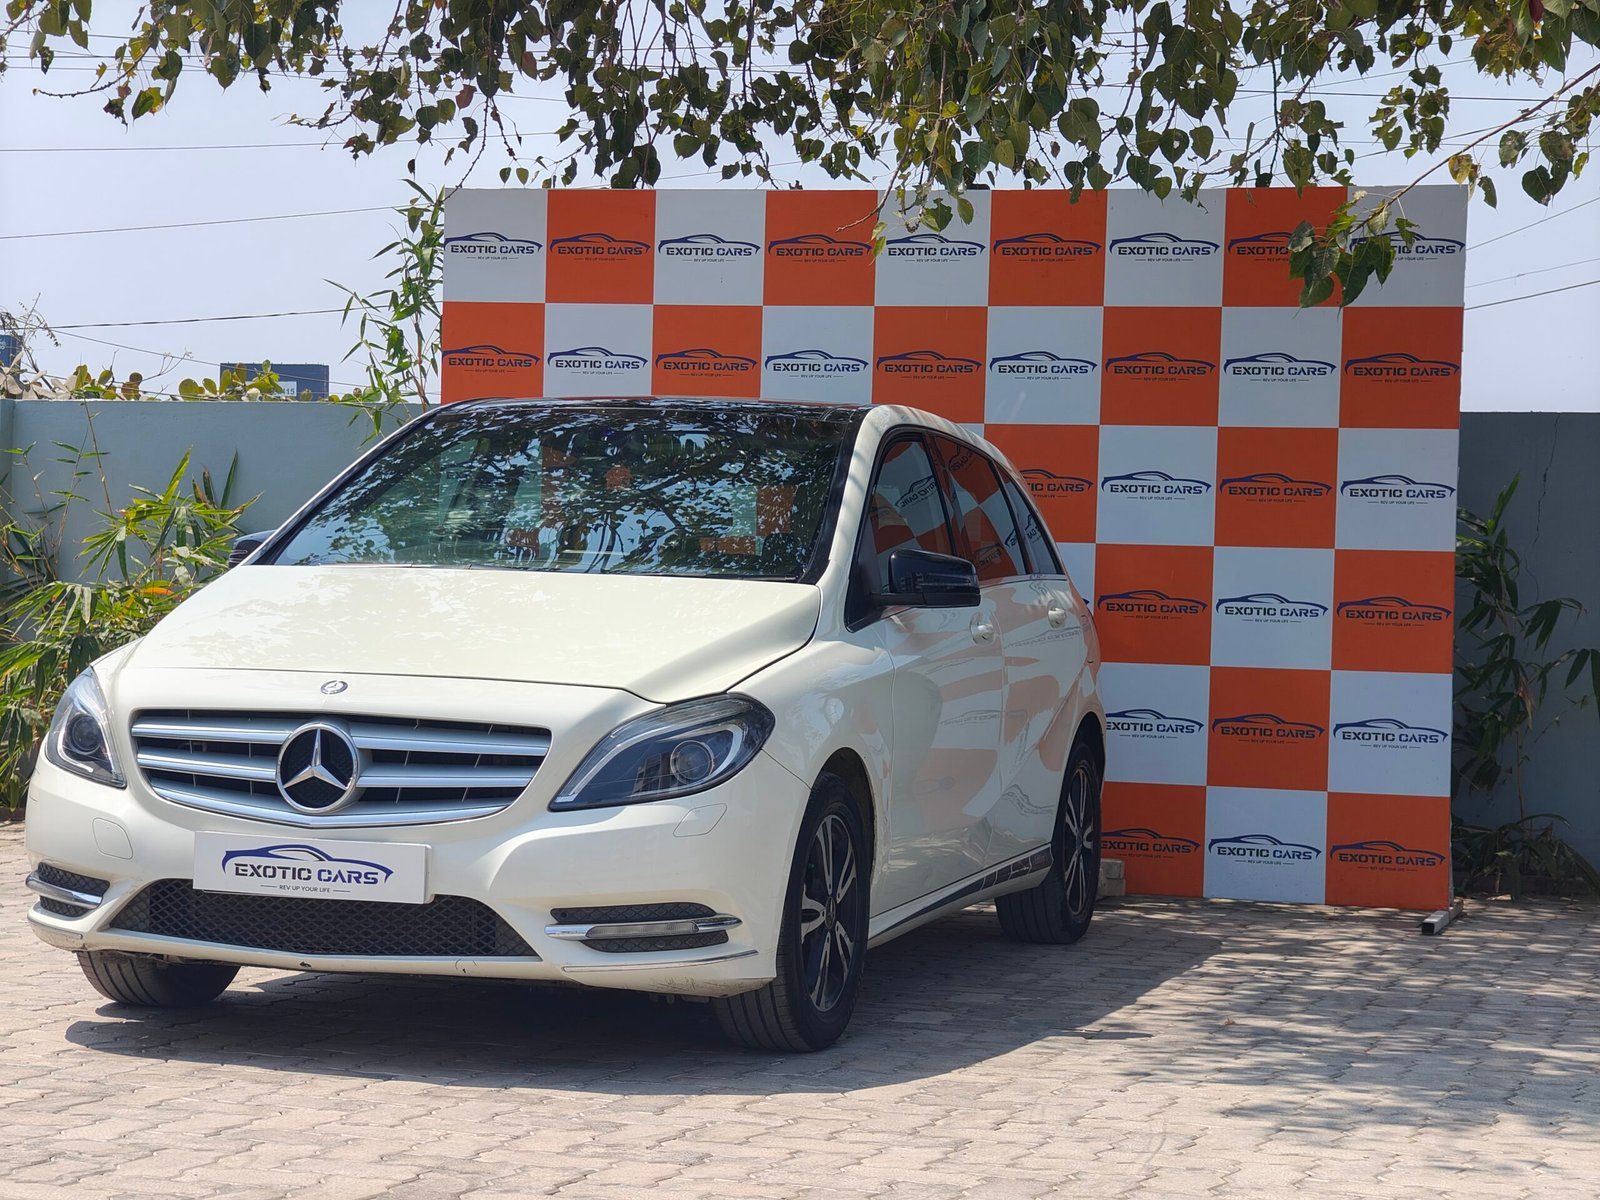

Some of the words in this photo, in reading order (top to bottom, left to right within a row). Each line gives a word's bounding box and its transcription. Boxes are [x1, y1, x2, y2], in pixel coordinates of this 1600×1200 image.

[451, 245, 497, 254] EXOTIC
[500, 245, 534, 254] CARS
[558, 246, 605, 255] EXOTIC
[607, 246, 642, 255] CARS
[666, 247, 714, 256] EXOTIC
[716, 247, 752, 256] CARS
[776, 247, 824, 256] EXOTIC
[828, 247, 863, 256] CARS
[888, 248, 937, 256] EXOTIC
[939, 247, 976, 256] CARS
[1002, 247, 1051, 256] EXOTIC
[1054, 247, 1092, 256] CARS
[1118, 246, 1169, 255] EXOTIC
[1172, 246, 1210, 255] CARS
[1415, 245, 1456, 254] CARS
[448, 358, 493, 367] EXOTIC
[497, 358, 532, 367] CARS
[555, 359, 602, 369] EXOTIC
[605, 360, 640, 369] CARS
[663, 361, 710, 371] EXOTIC
[713, 362, 749, 371] CARS
[773, 363, 821, 372] EXOTIC
[824, 363, 860, 372] CARS
[885, 364, 934, 373] EXOTIC
[936, 364, 973, 373] CARS
[998, 364, 1048, 374] EXOTIC
[1051, 365, 1088, 374] CARS
[1114, 365, 1165, 375] EXOTIC
[1168, 365, 1206, 375] CARS
[1233, 366, 1285, 376] EXOTIC
[1288, 366, 1327, 376] CARS
[1354, 367, 1407, 376] EXOTIC
[1411, 367, 1450, 377] CARS
[1046, 483, 1084, 492] CARS
[1110, 484, 1161, 494] EXOTIC
[1164, 485, 1202, 495] CARS
[1228, 486, 1280, 495] EXOTIC
[1284, 487, 1323, 496] CARS
[1349, 489, 1402, 498] EXOTIC
[1406, 489, 1446, 499] CARS
[1106, 603, 1156, 613] EXOTIC
[1161, 605, 1199, 614] CARS
[1225, 607, 1277, 617] EXOTIC
[1280, 608, 1319, 617] CARS
[1346, 610, 1398, 620] EXOTIC
[1402, 610, 1440, 620] CARS
[1156, 723, 1195, 734] CARS
[1221, 726, 1273, 736] EXOTIC
[1276, 728, 1315, 738] CARS
[1342, 731, 1395, 741] EXOTIC
[1399, 733, 1438, 743] CARS
[1153, 842, 1191, 853] CARS
[1217, 846, 1269, 857] EXOTIC
[1273, 849, 1312, 860] CARS
[1339, 853, 1392, 864] EXOTIC
[1396, 856, 1436, 867] CARS
[234, 863, 311, 881] EXOTIC
[317, 869, 378, 884] CARS
[301, 885, 318, 893] YOUR
[319, 886, 331, 894] LIFE
